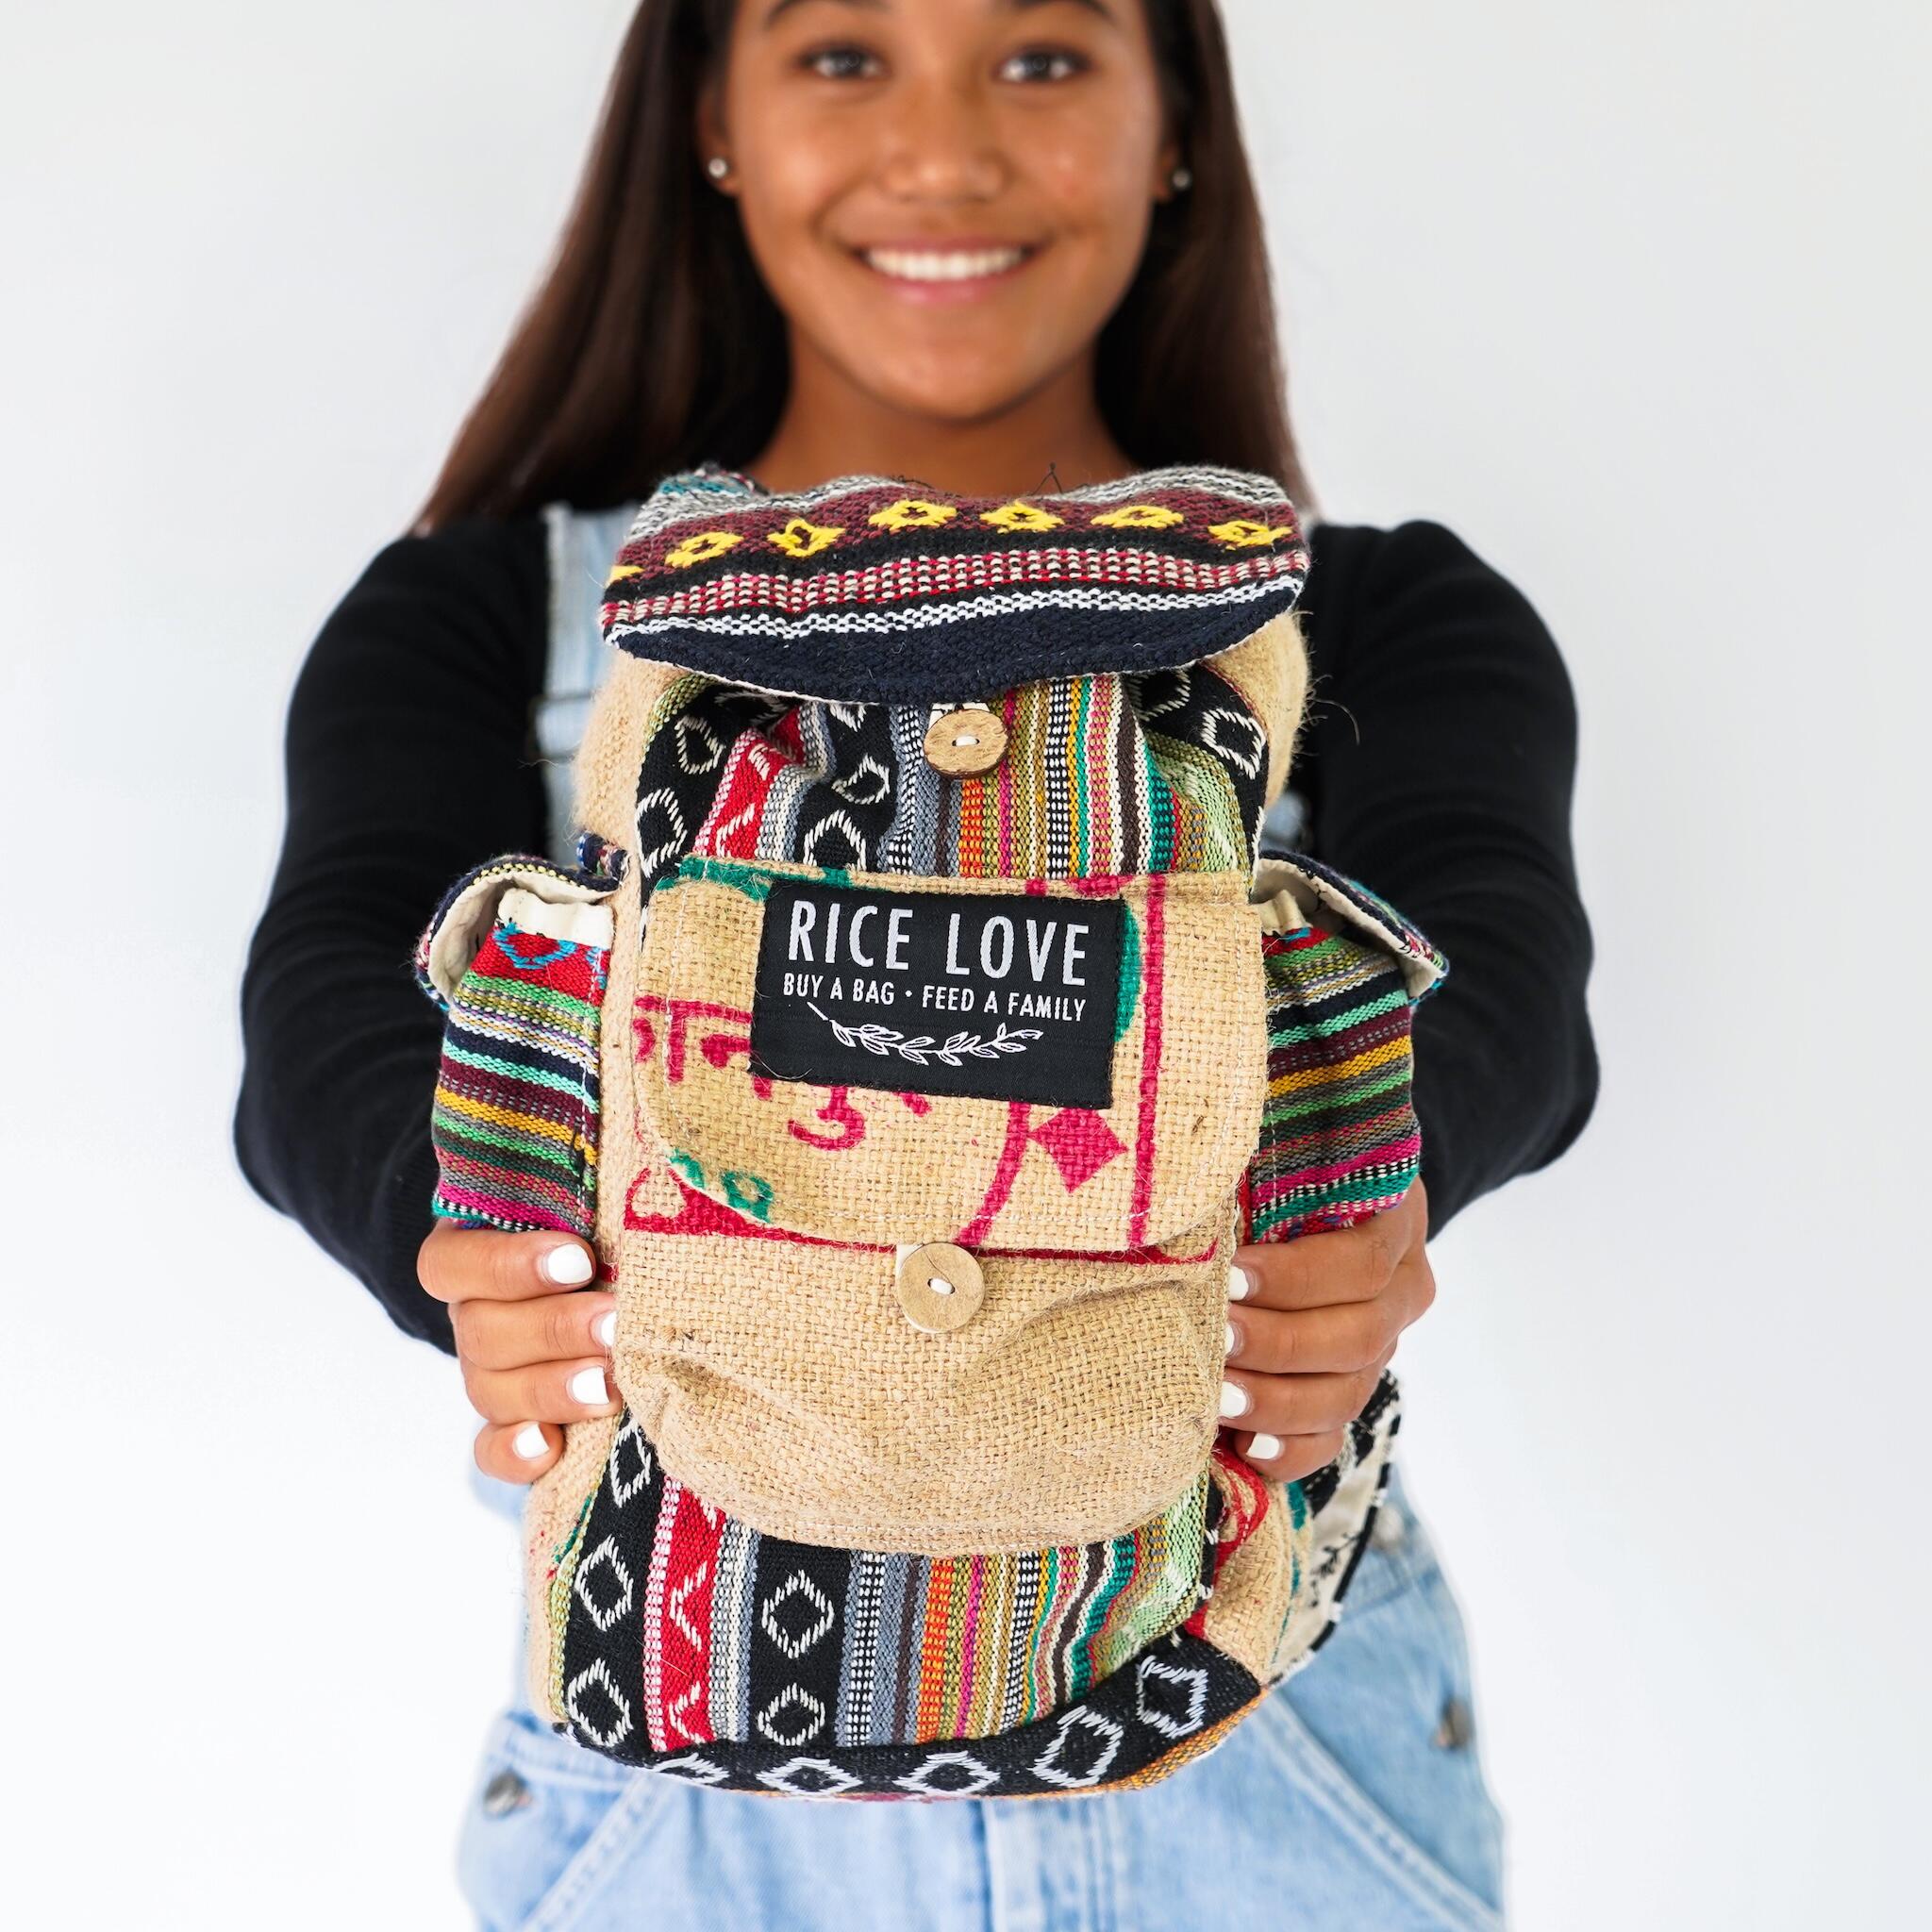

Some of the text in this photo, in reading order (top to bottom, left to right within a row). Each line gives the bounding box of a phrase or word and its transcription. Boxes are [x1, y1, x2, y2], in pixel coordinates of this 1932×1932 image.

[788, 899, 1090, 987] RICE LOVE
[783, 972, 1087, 1022] BUY A BAG FEED A FAMILY
